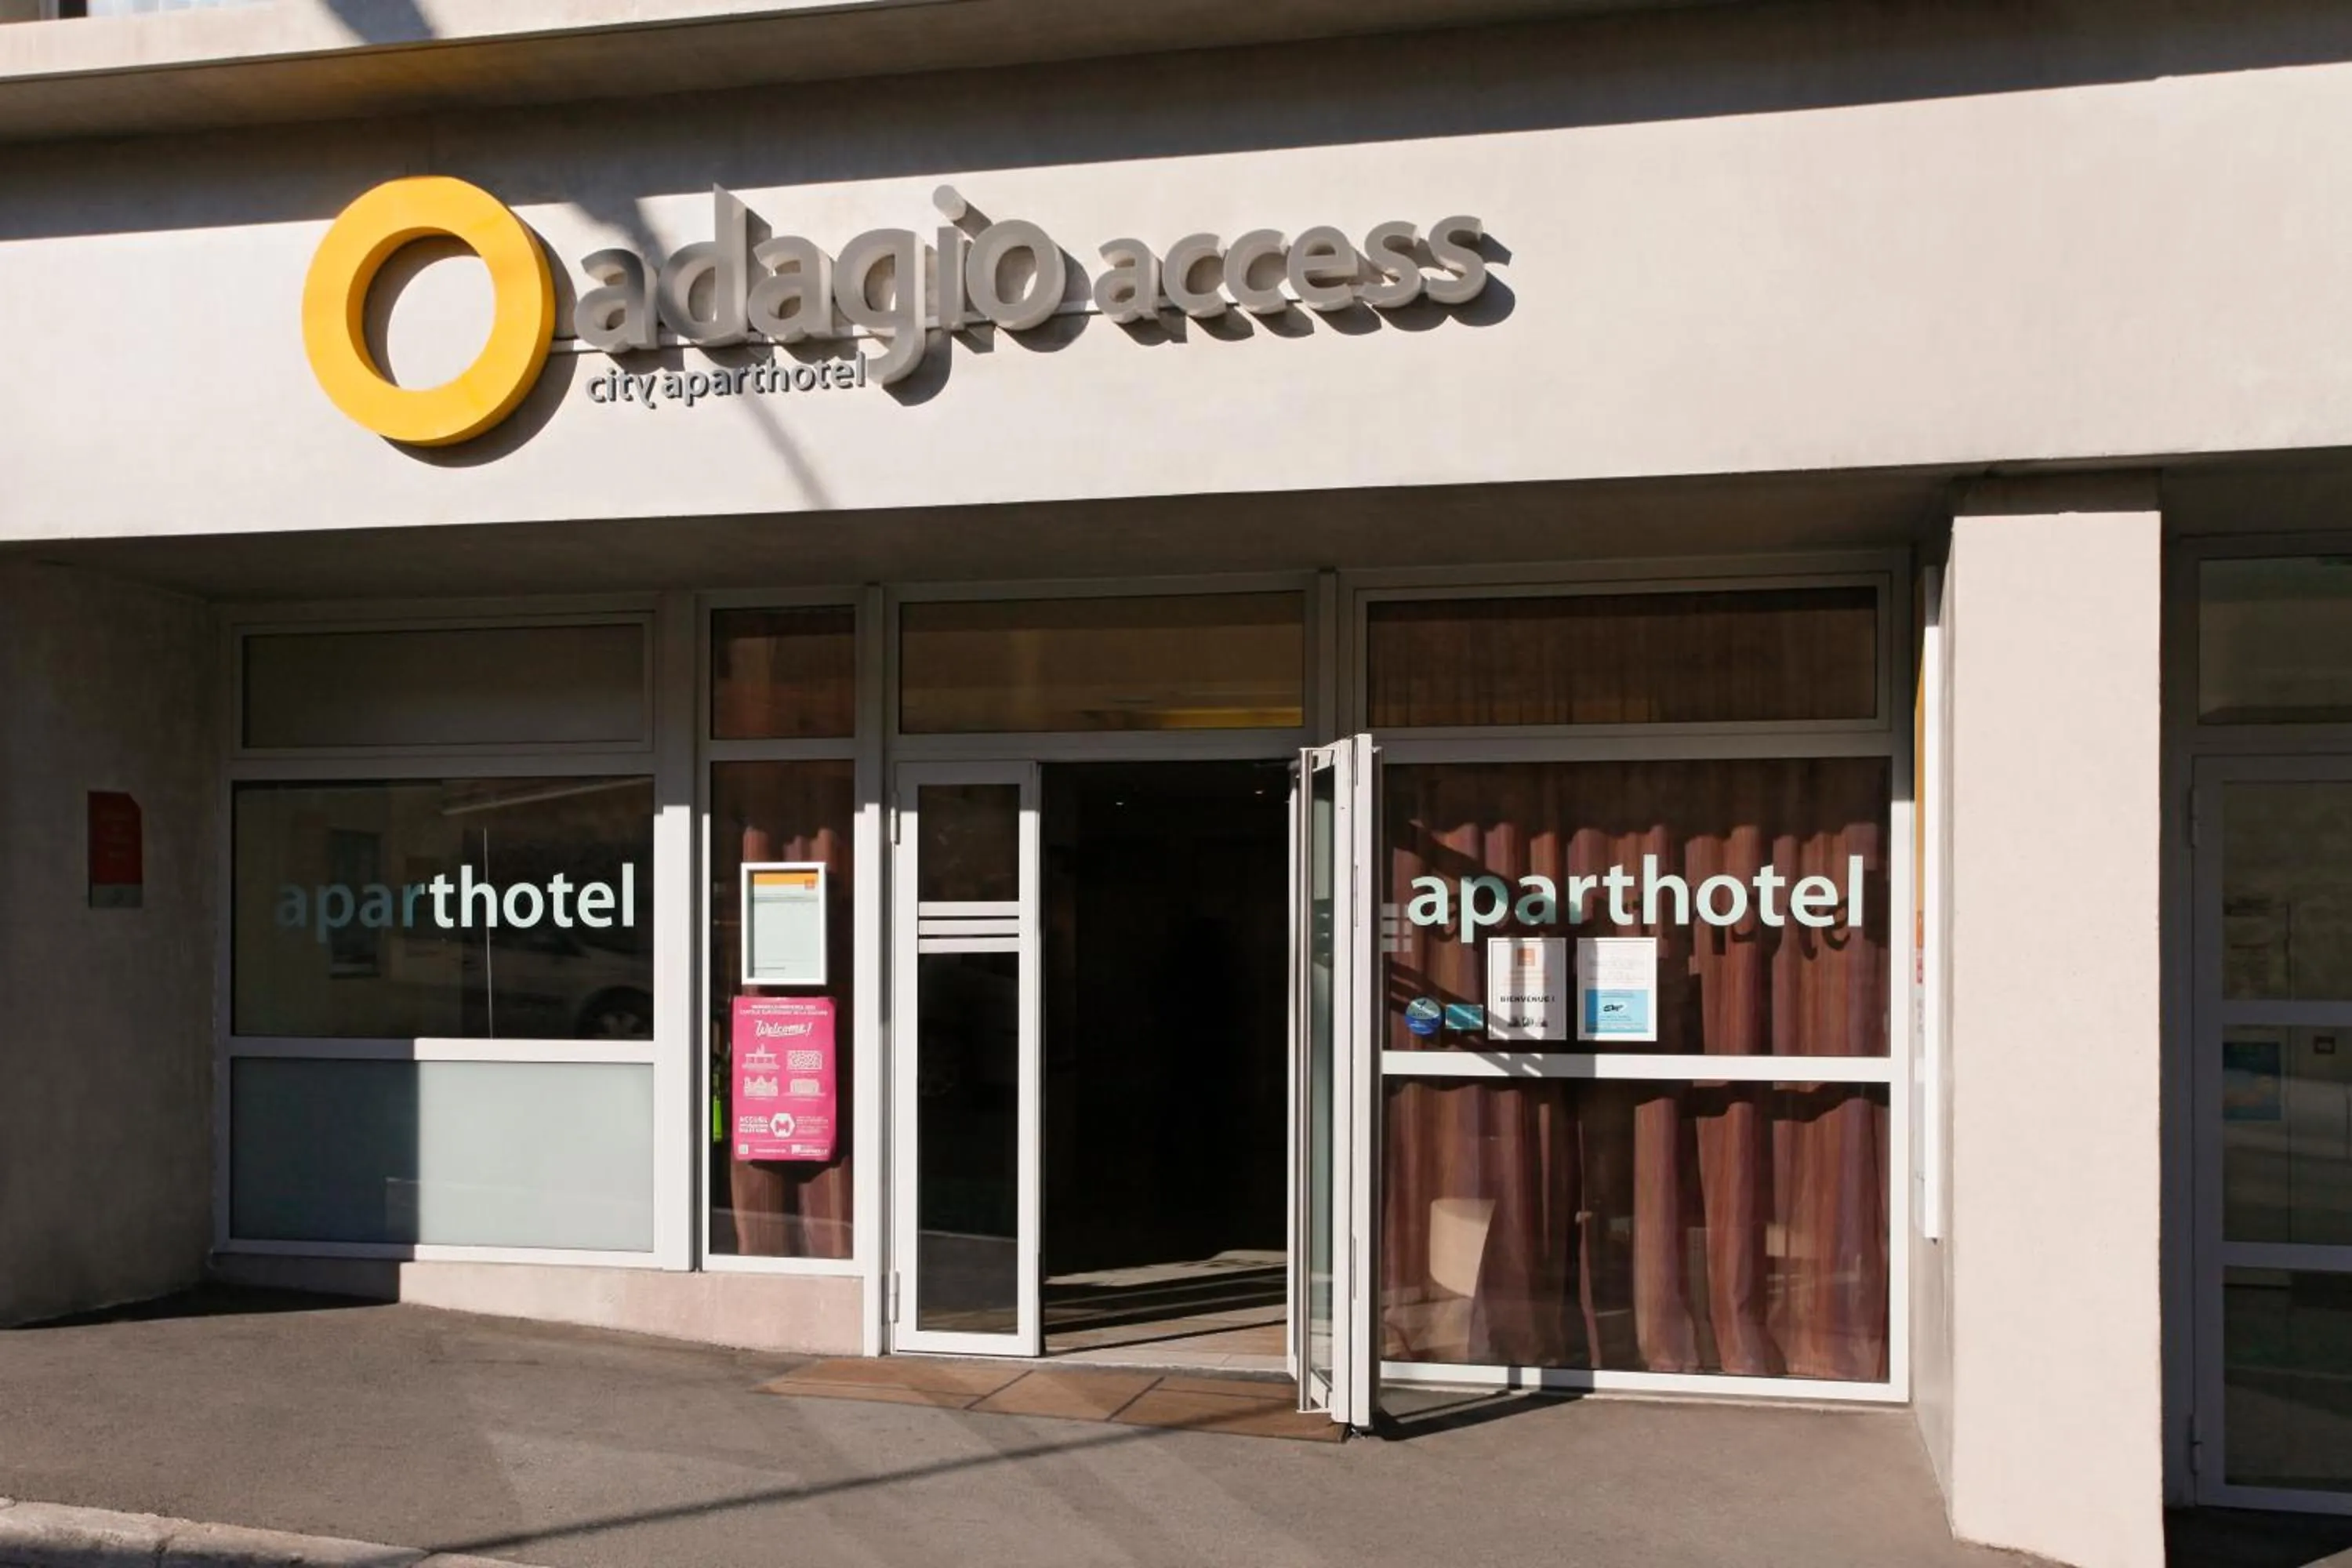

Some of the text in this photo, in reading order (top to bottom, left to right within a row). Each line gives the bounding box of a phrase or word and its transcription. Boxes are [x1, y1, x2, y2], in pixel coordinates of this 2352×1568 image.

[573, 183, 1488, 387] adagio access
[585, 350, 866, 408] city aparthotel
[275, 862, 634, 943] aparthotel
[1407, 854, 1864, 943] aparthotel
[1500, 994, 1550, 1004] BIENVENUE
